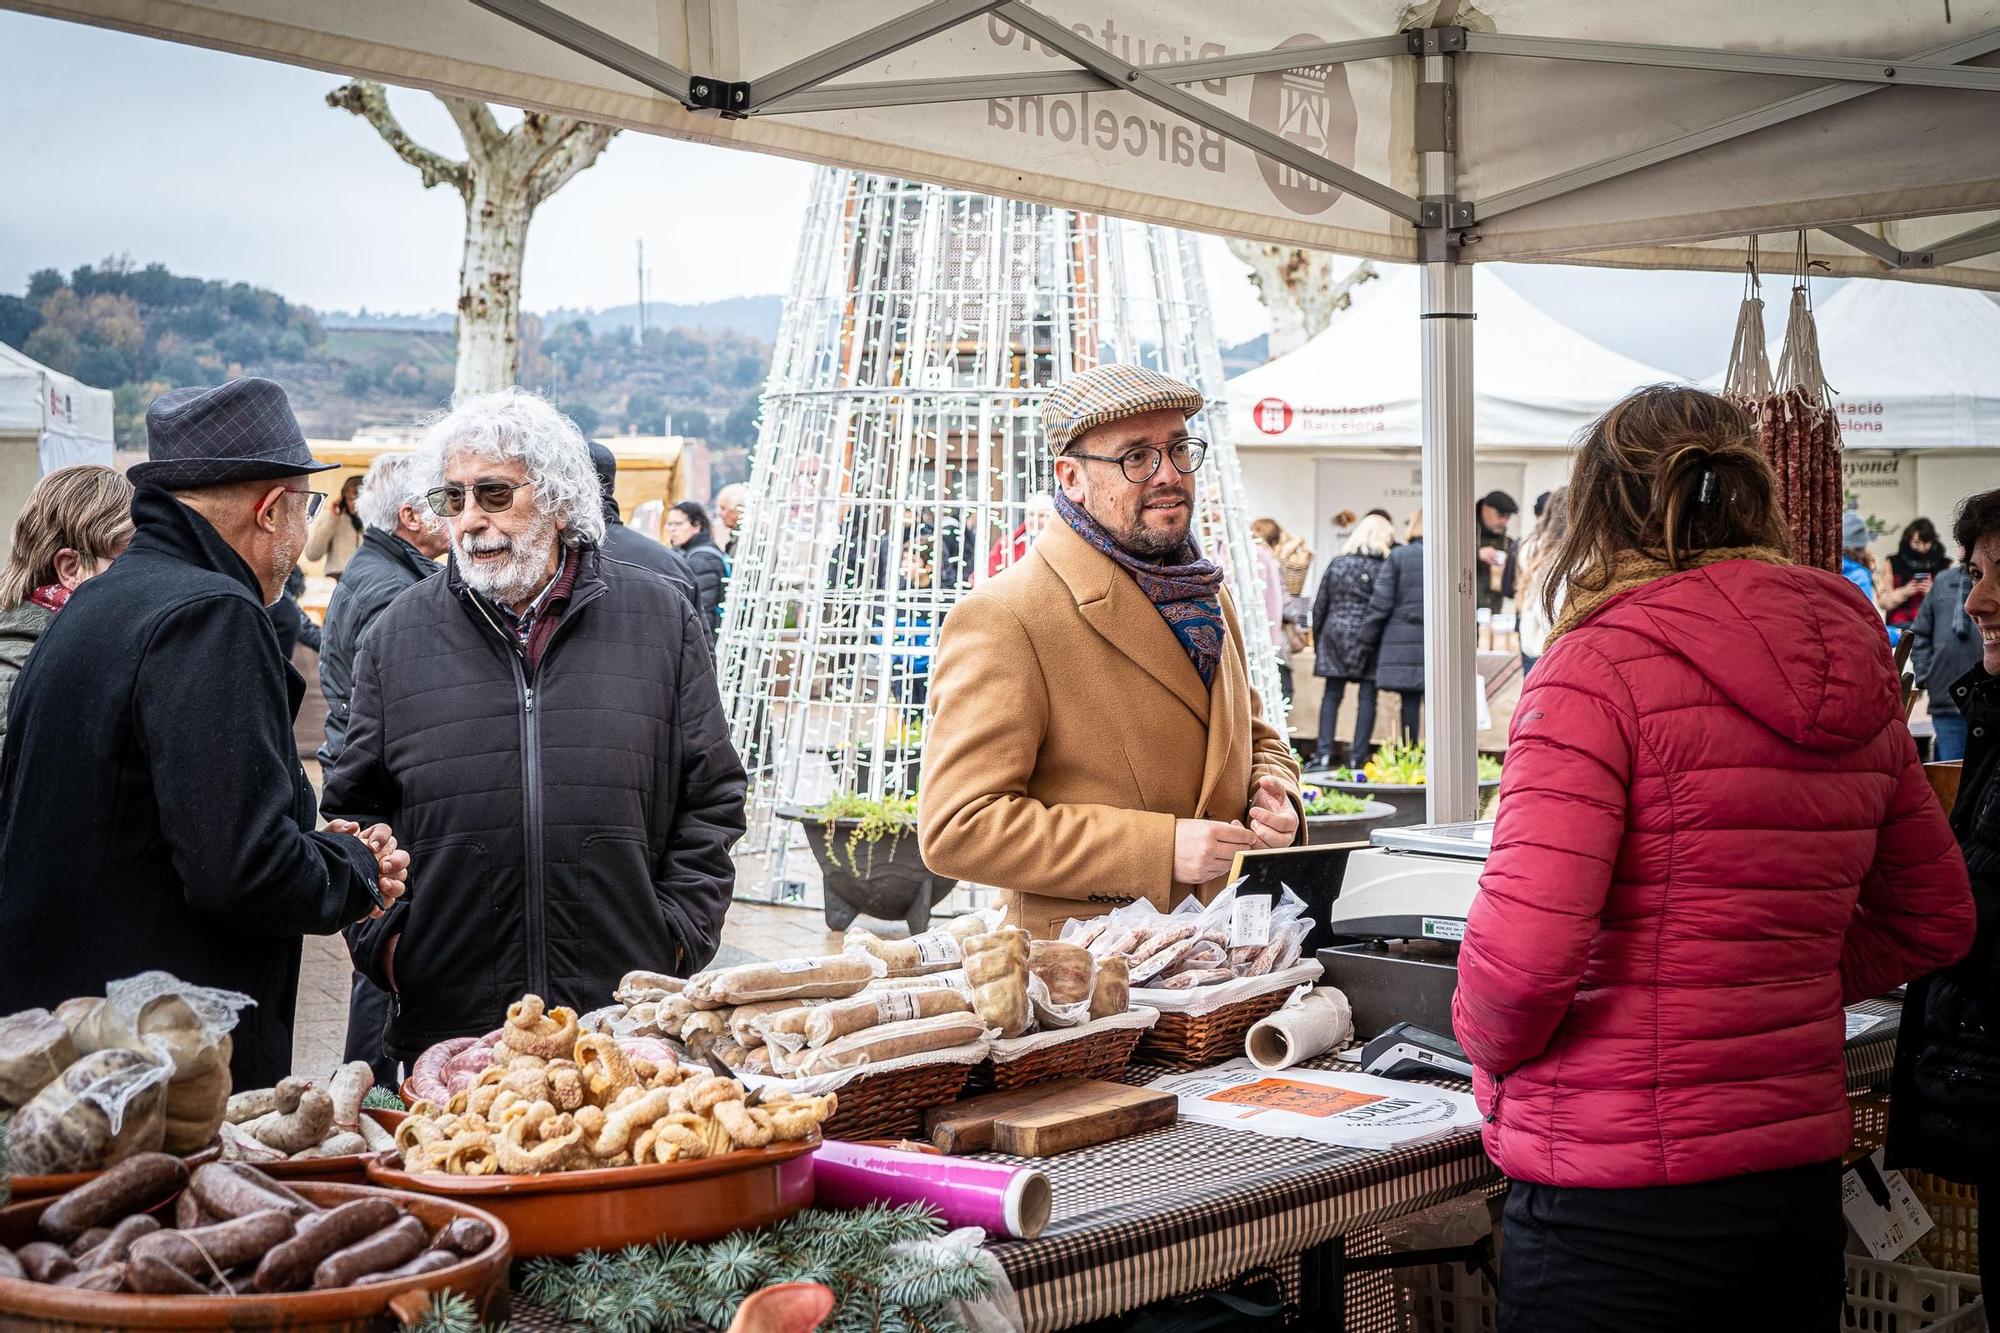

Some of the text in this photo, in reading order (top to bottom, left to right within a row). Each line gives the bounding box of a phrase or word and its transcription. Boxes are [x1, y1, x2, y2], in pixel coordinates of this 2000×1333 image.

[1836, 401, 1884, 415] tació
[1840, 420, 1883, 432] elona
[1843, 460, 1900, 478] yonet
